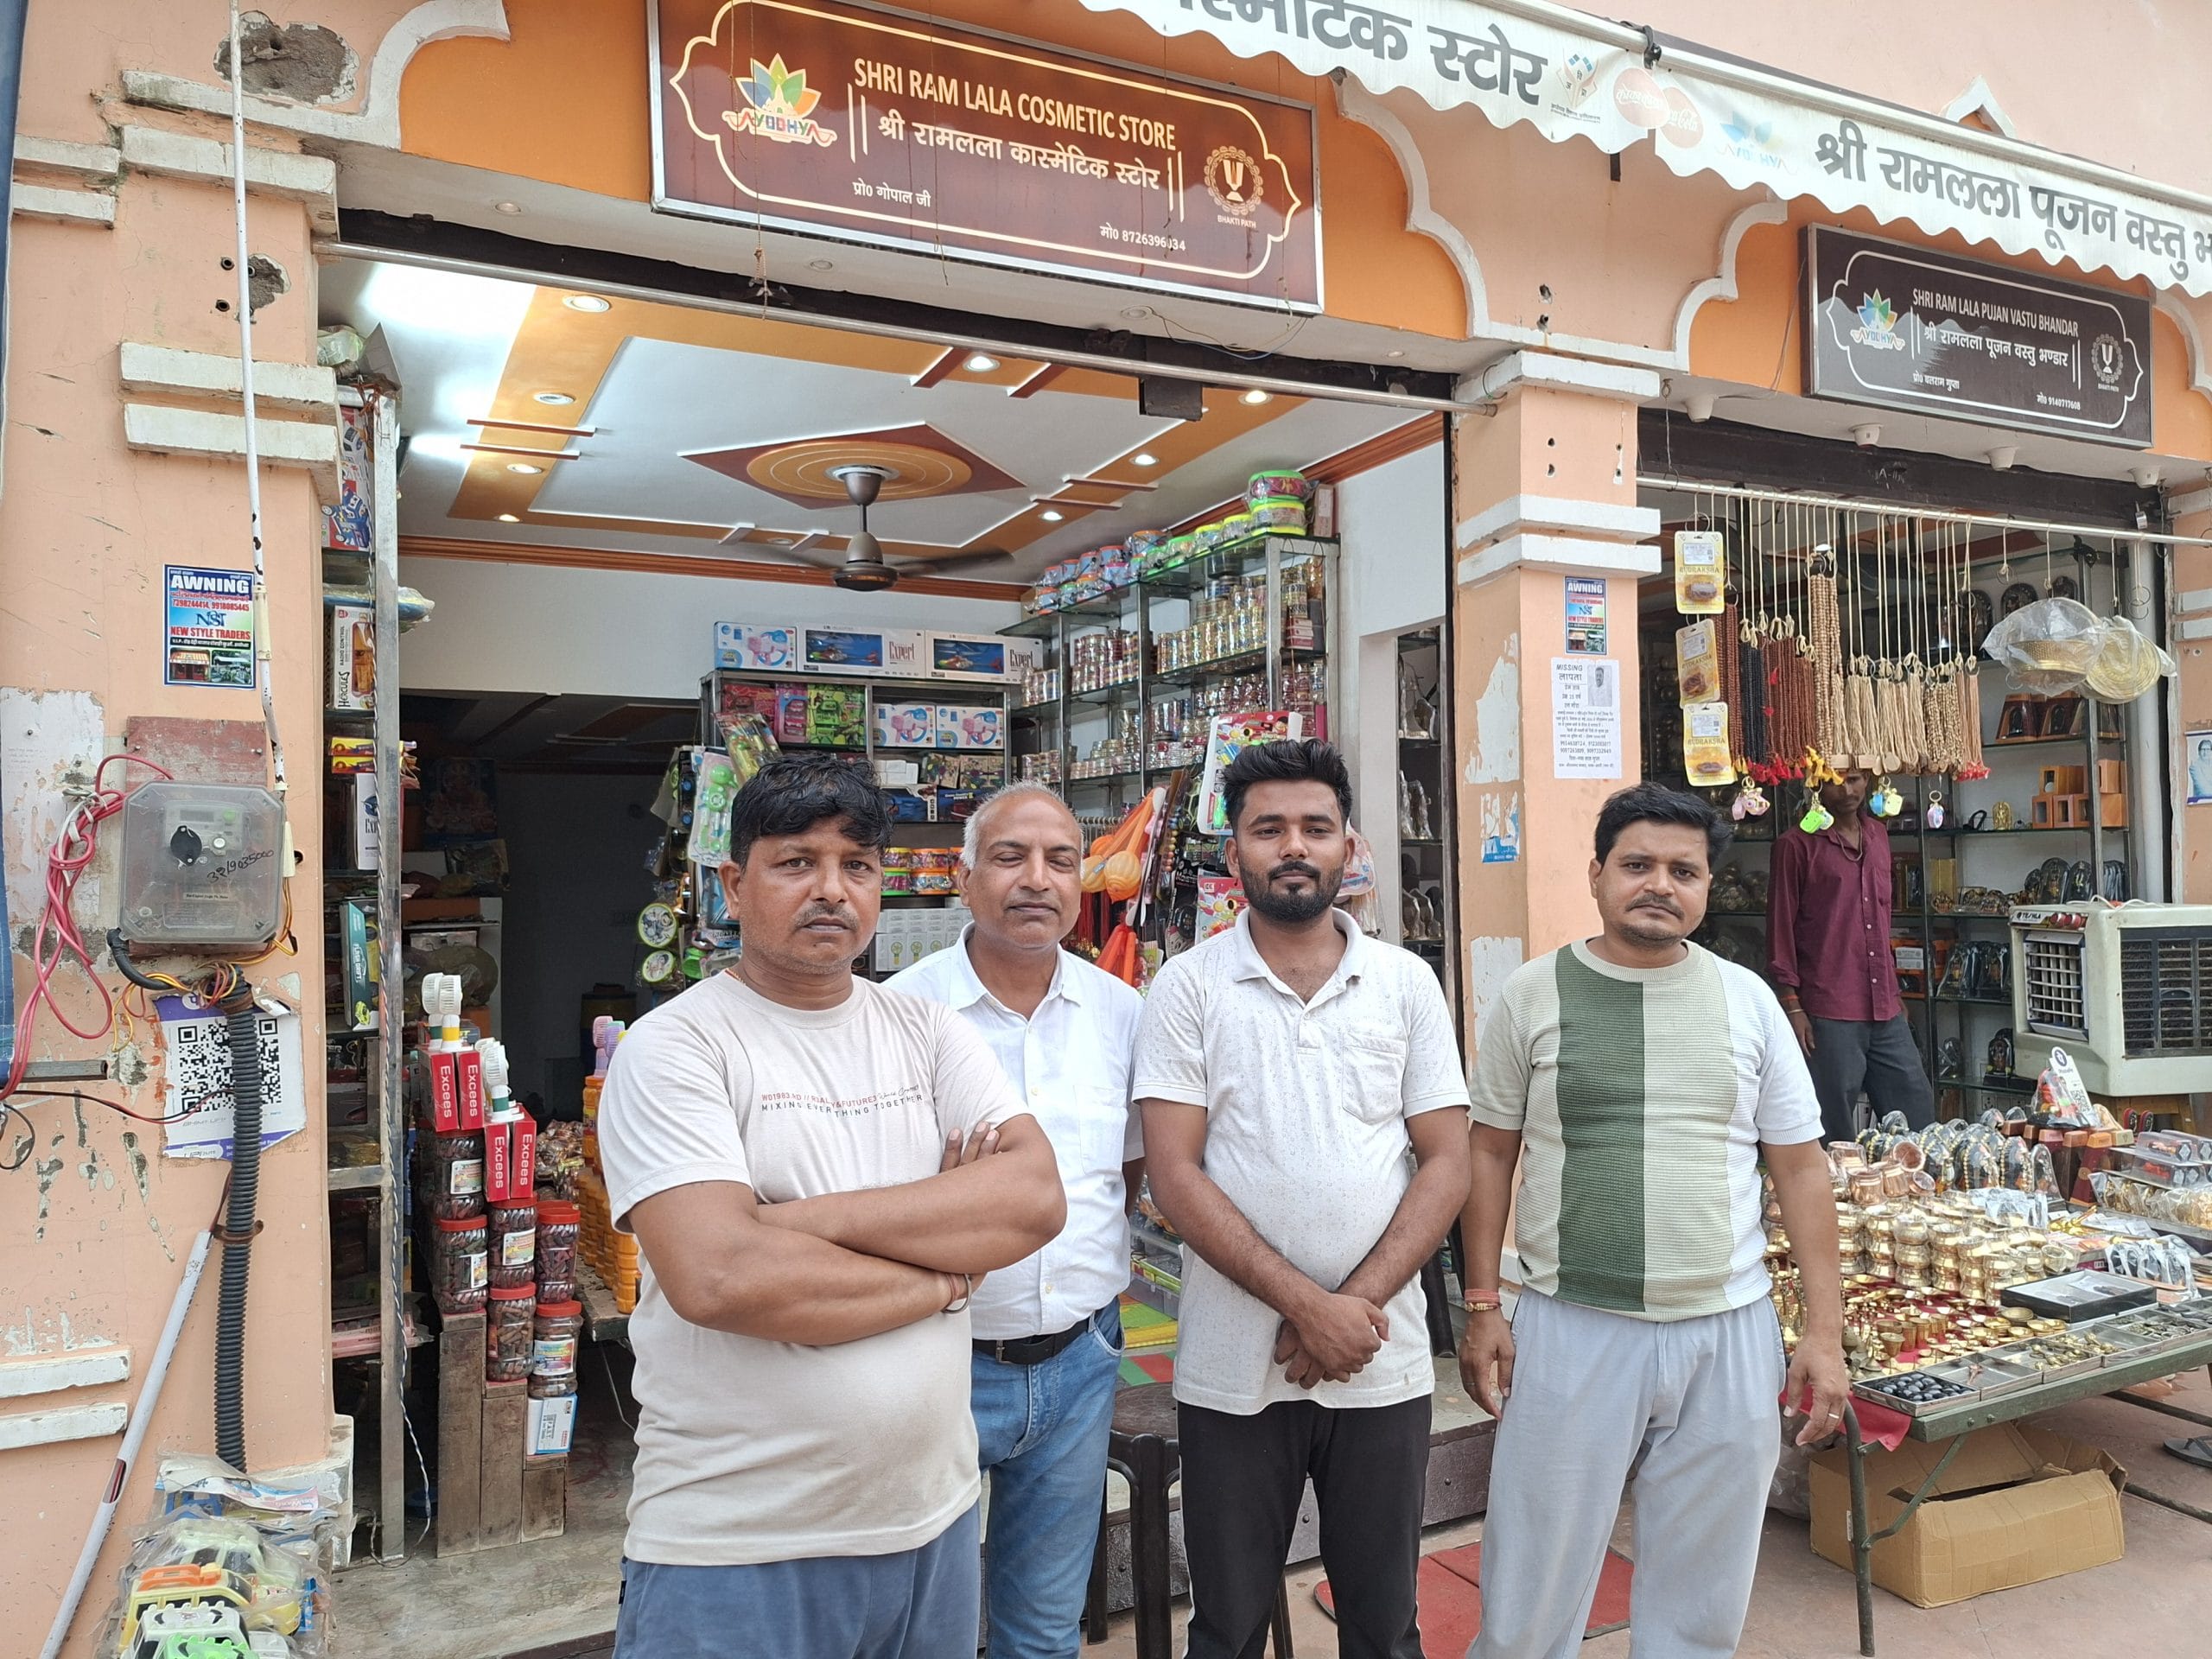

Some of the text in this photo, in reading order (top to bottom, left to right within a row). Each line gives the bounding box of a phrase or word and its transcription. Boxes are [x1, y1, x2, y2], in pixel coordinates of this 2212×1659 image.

[1427, 23, 1548, 105] स्टोर
[854, 58, 1176, 151] SHRI RAM LALA COSMETIC STORE
[877, 108, 1160, 190] श्री रामलला कास्मेटिक स्टोर
[876, 182, 912, 204] गोपाल
[916, 191, 931, 208] जी
[1815, 119, 1867, 182] श्री
[1876, 146, 2021, 220] रामलला
[2029, 185, 2118, 251] पूजन
[2125, 208, 2190, 282] वस्तु
[1217, 214, 1256, 229] BHAKTI PATH
[1912, 288, 2079, 338] SHRI RAM LALA PUJAN VASTU BHANDAR
[1923, 321, 2069, 367] श्री रामलला पूजन वस्तु भण्डार
[171, 575, 250, 594] AWNING
[1567, 582, 1603, 594] AWNING
[170, 626, 251, 640] NEW STYLE TRADERS
[441, 1065, 452, 1119] Excees
[467, 1065, 479, 1117] Excees
[874, 1094, 923, 1111] TOGETHER
[495, 1136, 505, 1189] Excees
[520, 1134, 532, 1185] Excees
